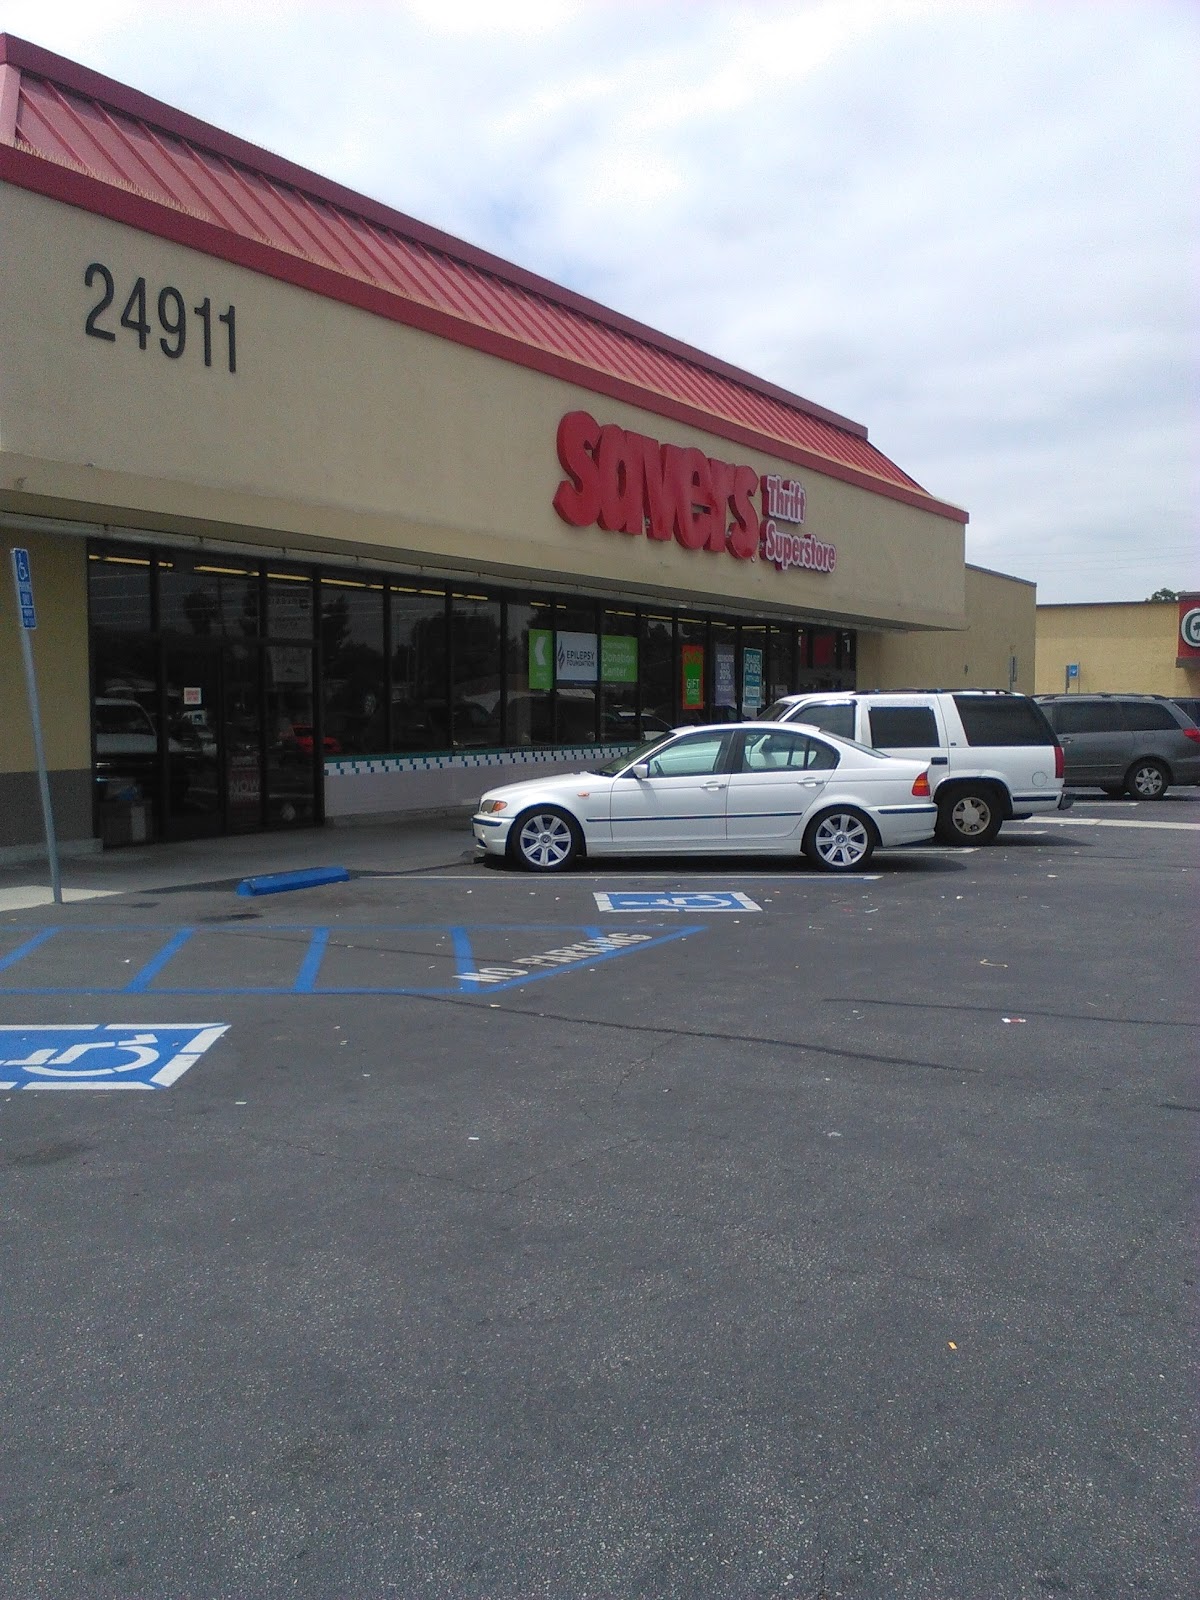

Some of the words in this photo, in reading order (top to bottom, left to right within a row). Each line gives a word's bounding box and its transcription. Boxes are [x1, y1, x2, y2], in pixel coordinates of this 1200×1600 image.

[85, 263, 236, 373] 24911
[760, 474, 806, 524] Thrift
[760, 520, 837, 573] Superstore
[566, 650, 595, 660] EPILEPSY
[602, 650, 635, 663] Donation
[566, 659, 595, 667] FOUNDATION
[602, 664, 627, 677] Center
[686, 678, 700, 688] GIFT
[452, 966, 529, 983] NO
[512, 932, 652, 967] PARKING
